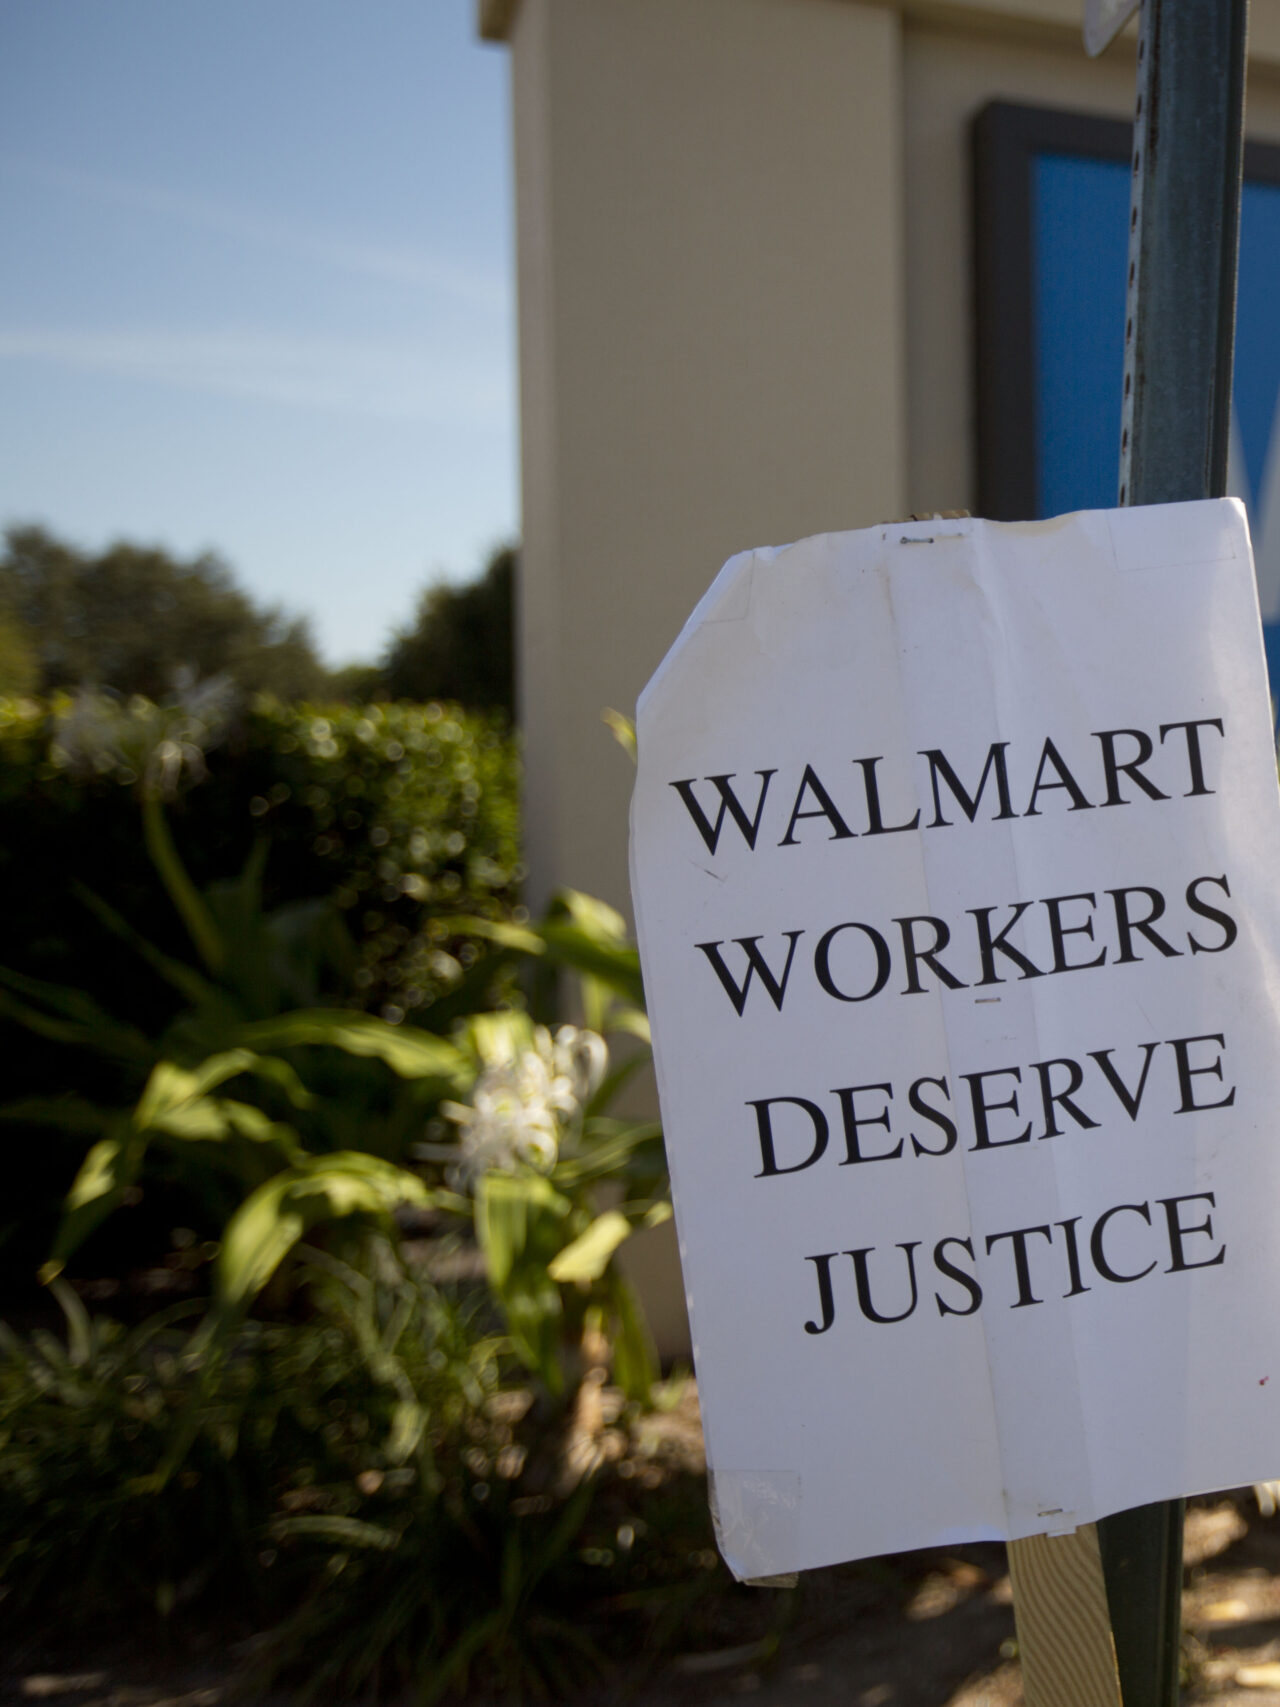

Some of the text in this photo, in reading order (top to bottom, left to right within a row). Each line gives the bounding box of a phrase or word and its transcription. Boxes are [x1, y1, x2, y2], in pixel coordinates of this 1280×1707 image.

[668, 718, 1226, 857] WALMART
[693, 874, 1238, 1018] WORKERS
[744, 1033, 1236, 1179] DESERVE
[803, 1191, 1227, 1335] JUSTICE
